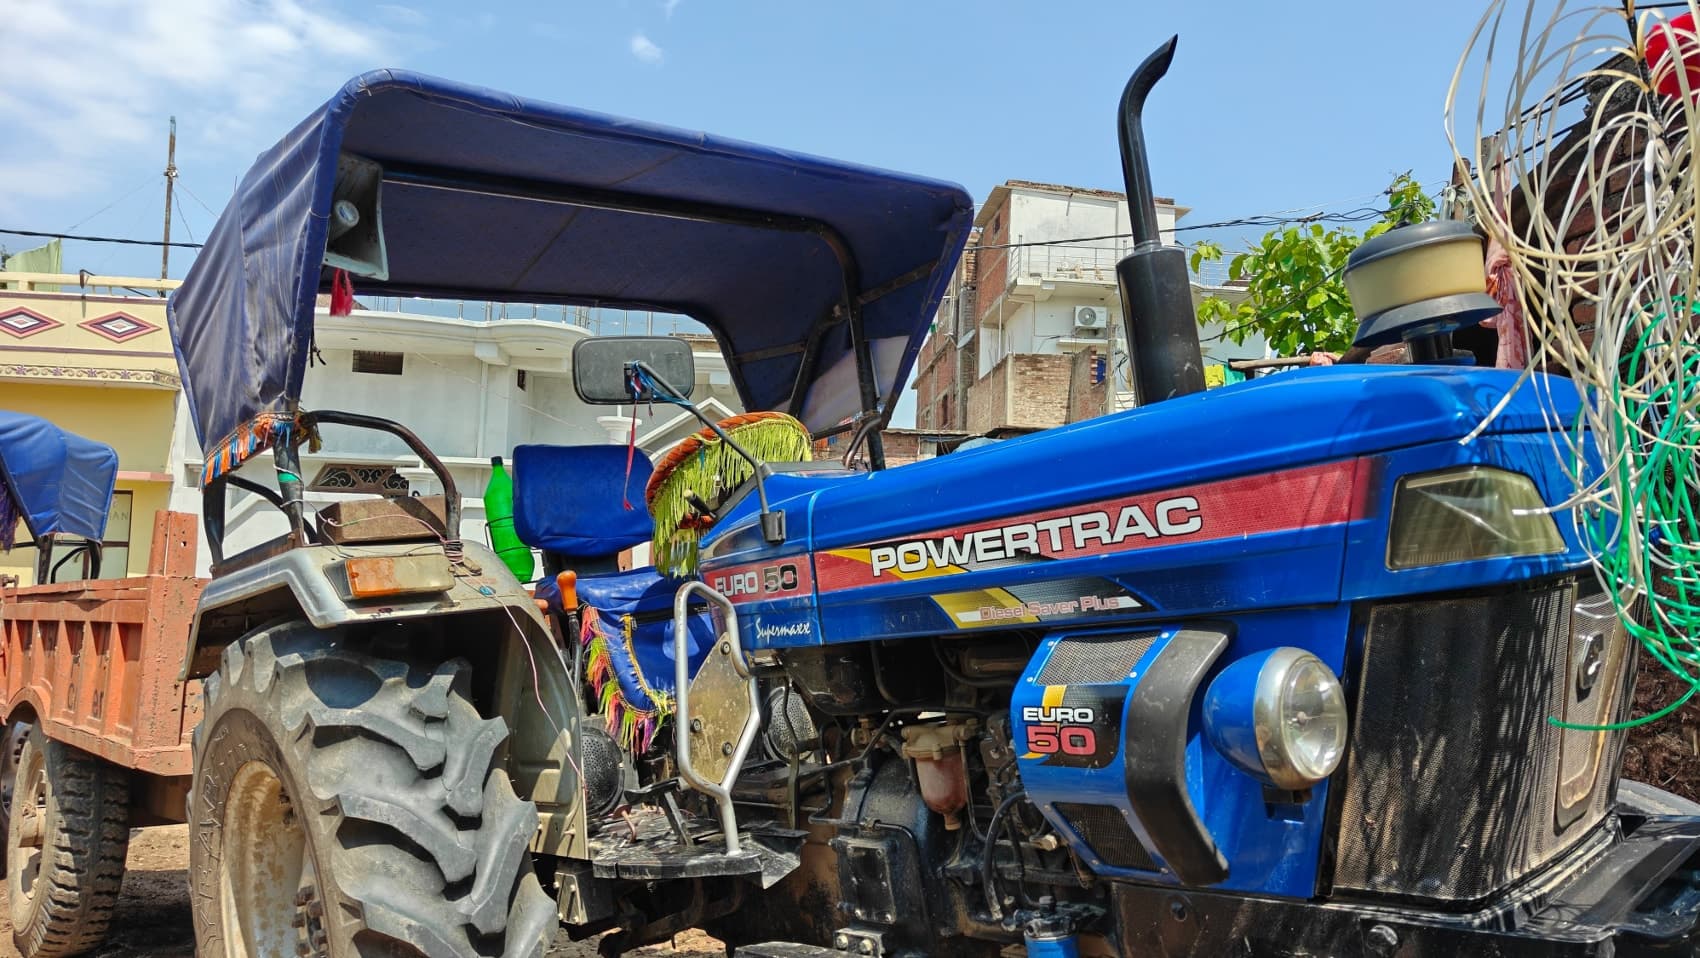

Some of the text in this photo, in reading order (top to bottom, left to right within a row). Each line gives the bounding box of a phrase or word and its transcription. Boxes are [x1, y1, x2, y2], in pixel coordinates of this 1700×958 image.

[869, 496, 1203, 577] POWERTRAC
[714, 562, 798, 597] EURO 50
[979, 596, 1120, 621] Diesel Saver Plus
[1022, 706, 1095, 723] EURO
[1026, 725, 1097, 756] 50
